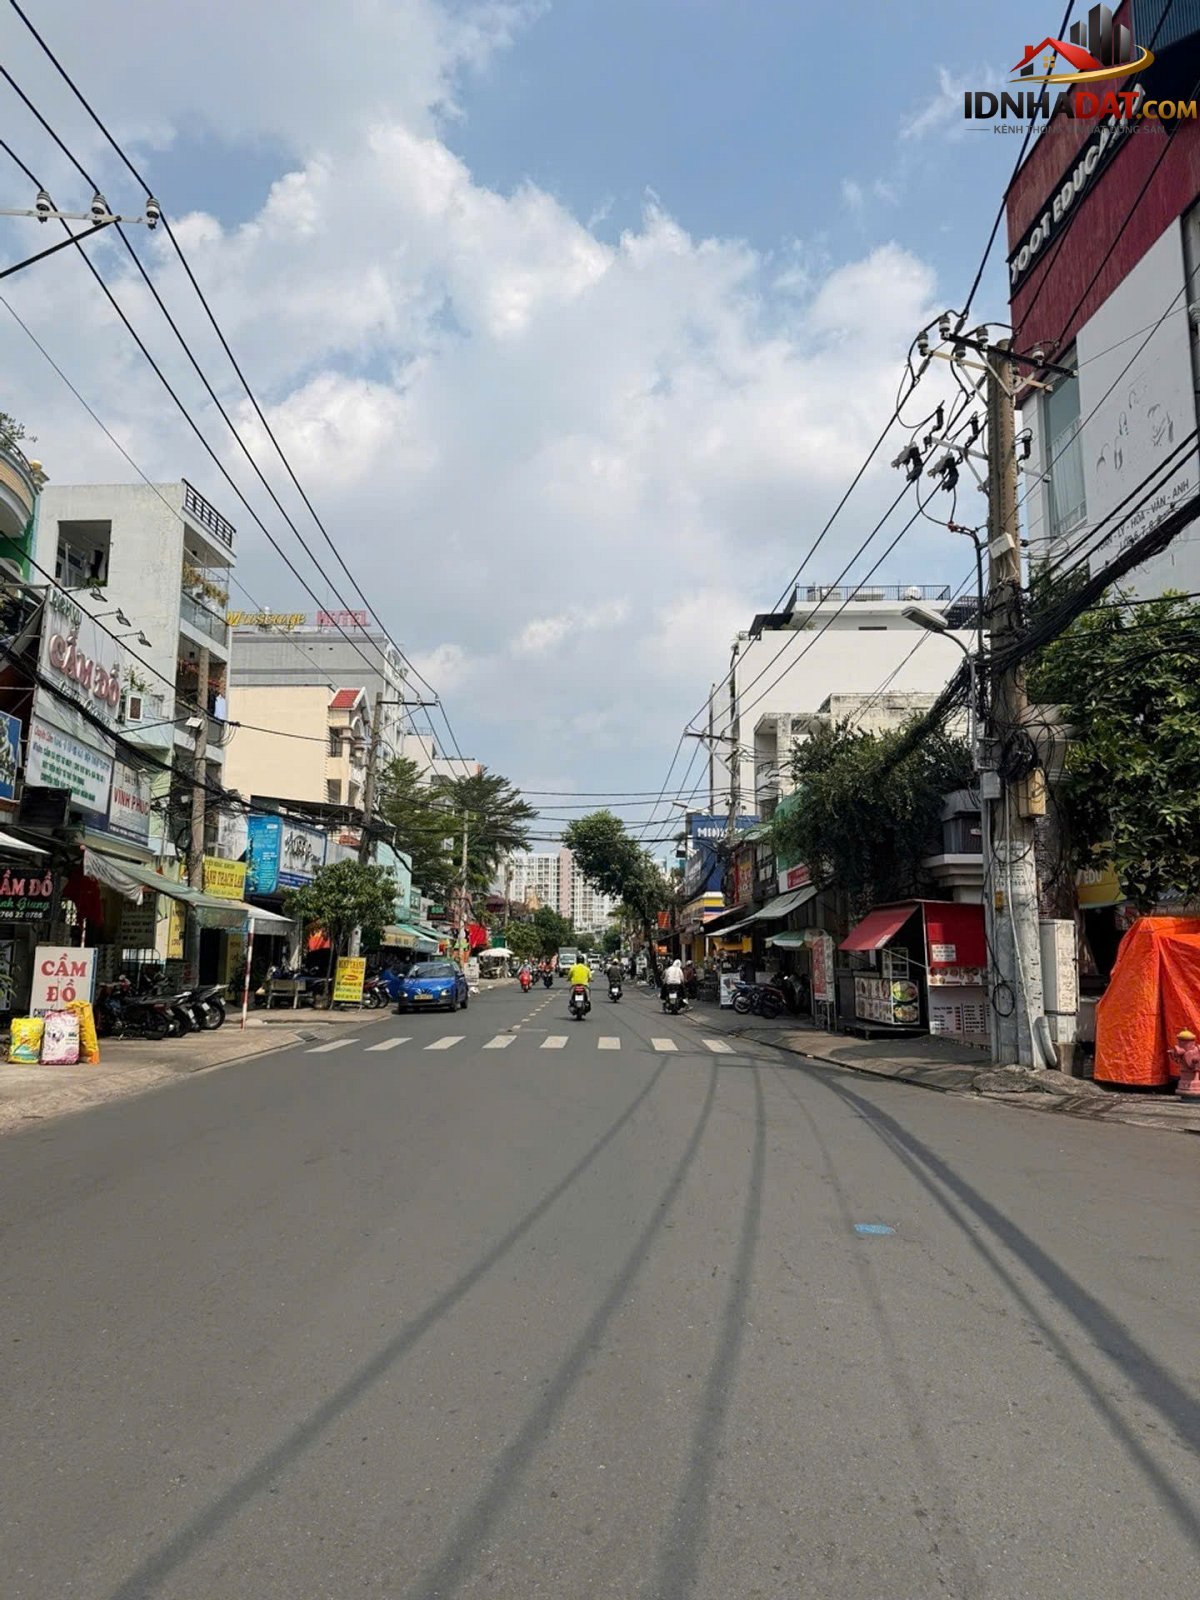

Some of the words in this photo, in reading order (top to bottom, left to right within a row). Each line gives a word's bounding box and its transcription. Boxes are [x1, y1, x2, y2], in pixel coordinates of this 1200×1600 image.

[1172, 478, 1190, 499] ANH
[41, 953, 88, 977] CẦM
[46, 979, 76, 1002] ĐỒ
